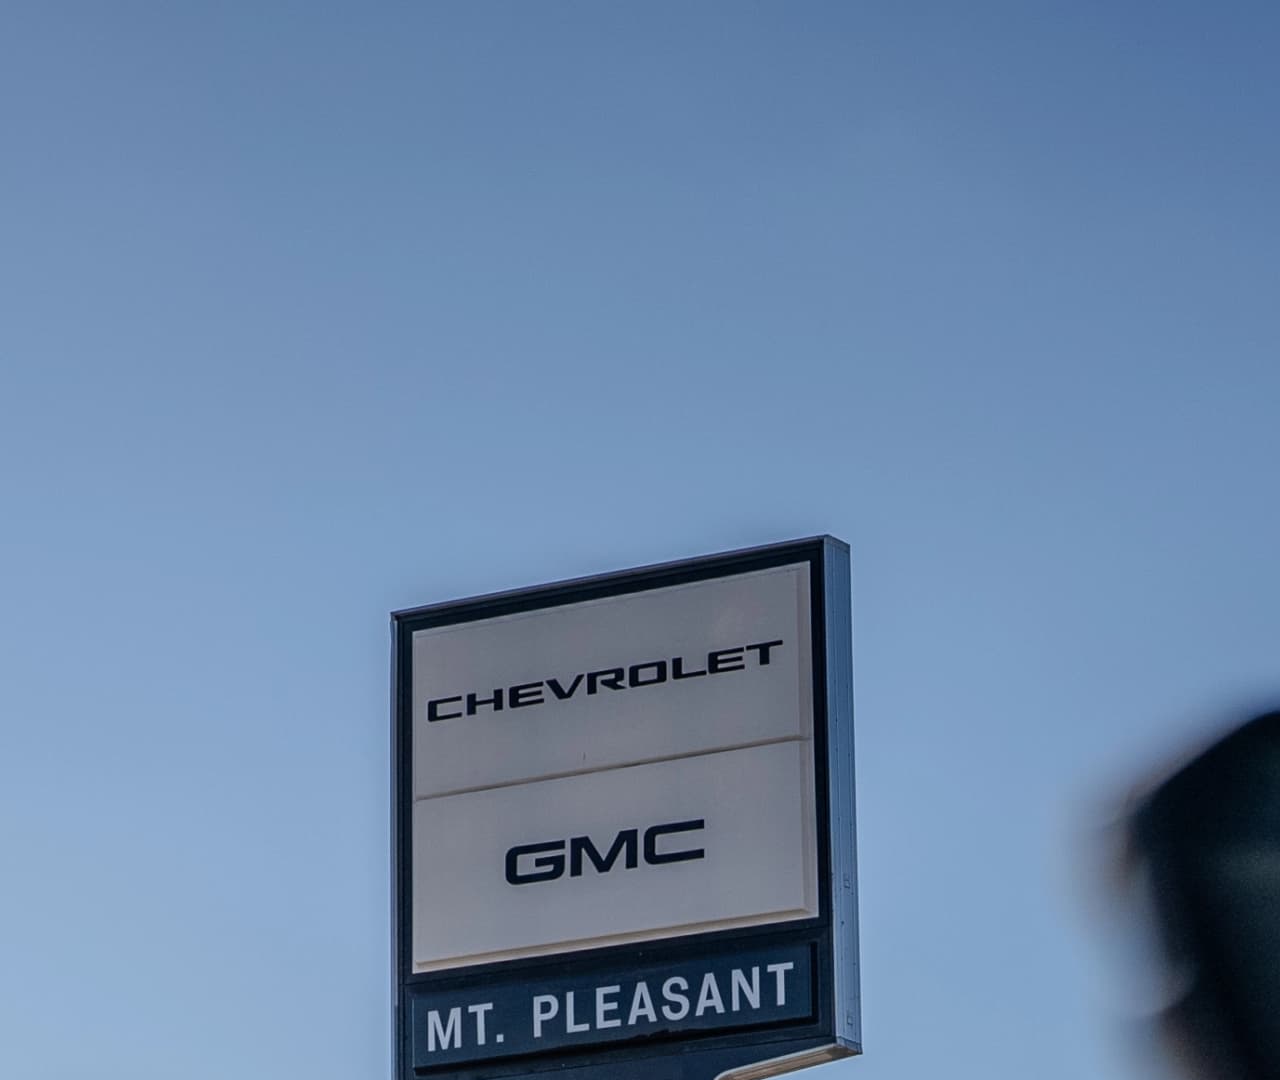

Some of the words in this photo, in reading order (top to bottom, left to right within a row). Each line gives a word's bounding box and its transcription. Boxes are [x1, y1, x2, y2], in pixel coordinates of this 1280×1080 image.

[427, 639, 784, 723] CHEVROLET
[505, 818, 705, 886] GMC
[426, 1002, 505, 1053] MT.
[532, 961, 795, 1039] PLEASANT
